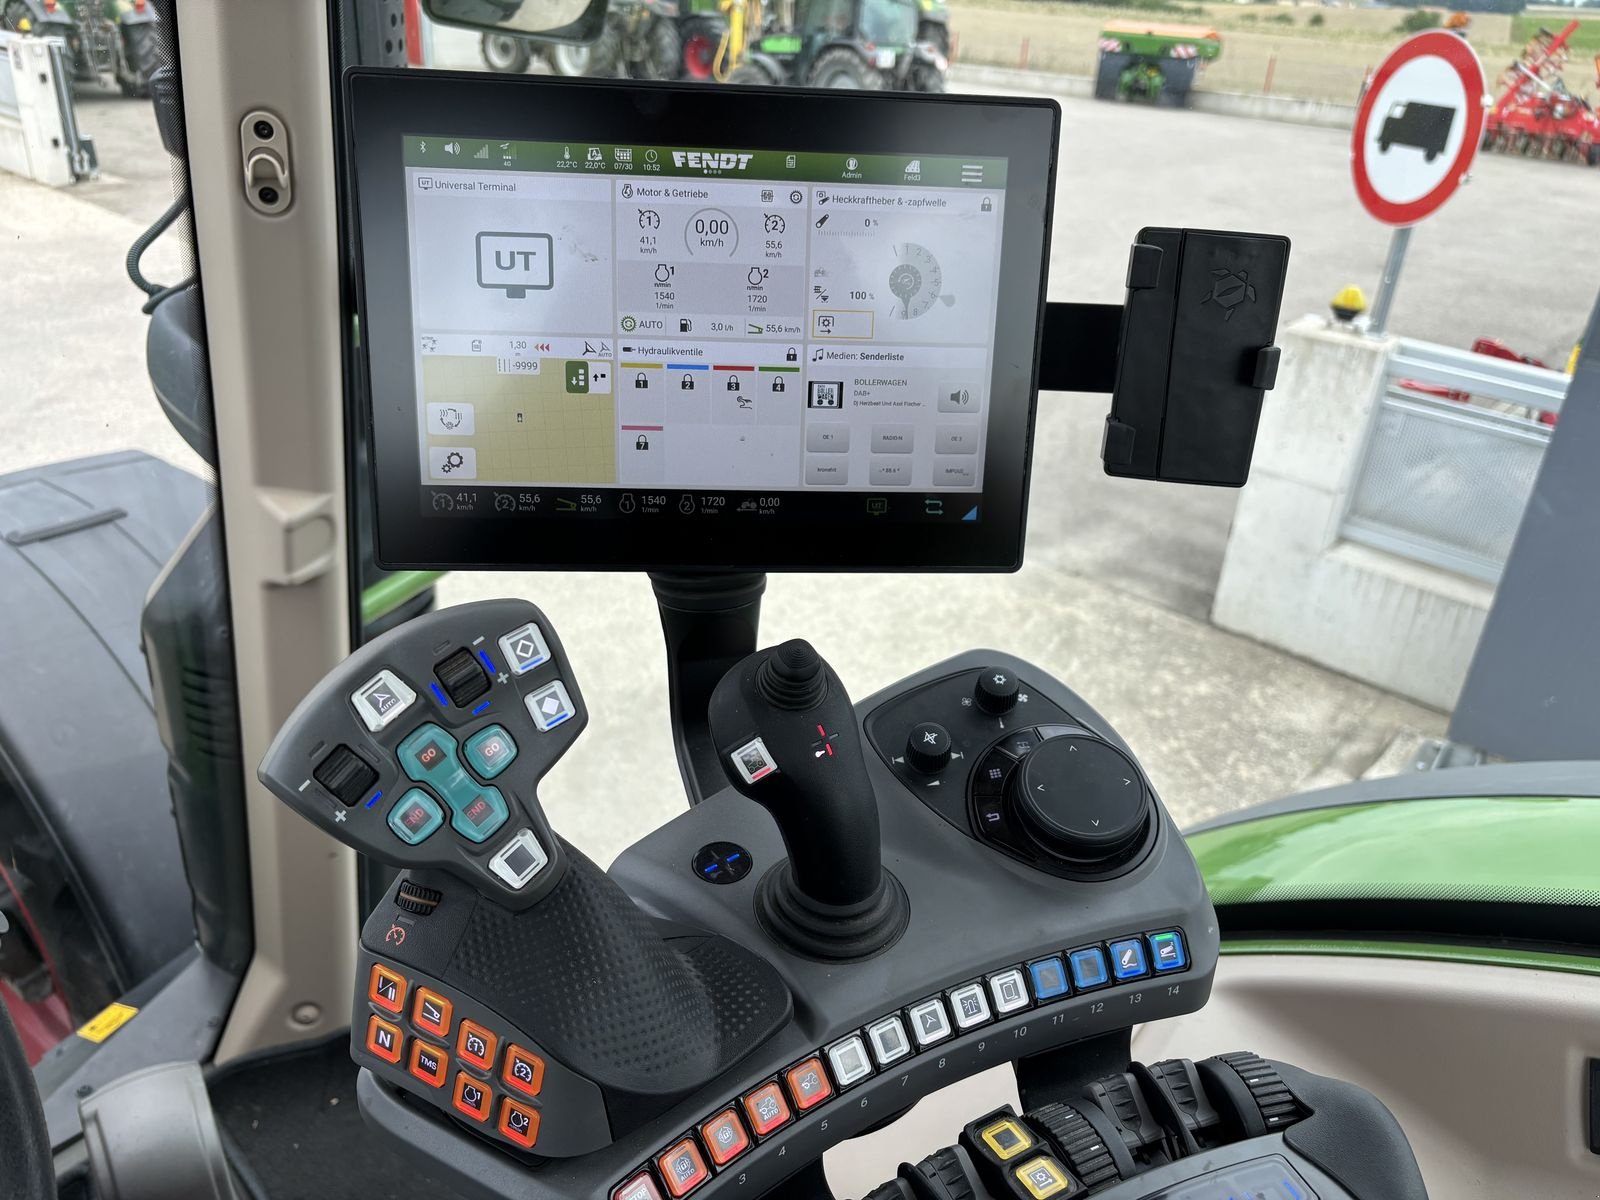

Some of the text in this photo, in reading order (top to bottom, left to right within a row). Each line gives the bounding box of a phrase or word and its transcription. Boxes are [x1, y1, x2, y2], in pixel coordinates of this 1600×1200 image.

[556, 160, 578, 168] 22,2°C
[672, 151, 754, 170] FENDT
[585, 162, 606, 170] 22,0°C
[614, 162, 633, 170] 07/30
[842, 171, 862, 180] Admin
[435, 181, 516, 192] Universal Terminal
[637, 188, 708, 198] Motor & Getriebe
[832, 194, 896, 206] Heckkraftheber
[904, 198, 946, 208] -zapfwelle
[695, 218, 729, 236] 0,00
[864, 218, 870, 228] 0
[640, 236, 657, 246] 41,1
[700, 238, 724, 248] km/h
[765, 240, 783, 250] 55,6
[765, 250, 782, 258] km/h
[495, 250, 536, 272] UT
[654, 292, 675, 300] 1540
[747, 294, 768, 304] 1720
[850, 291, 867, 300] 100
[655, 302, 674, 310] 1/min
[639, 320, 663, 329] AUTO
[711, 322, 724, 332] 3,0
[766, 324, 800, 334] 55,6 km/h
[509, 340, 527, 350] 1,30
[638, 346, 704, 357] Hydraulikventile
[826, 352, 904, 361] Medien: Senderliste
[512, 361, 538, 371] -9999
[854, 378, 908, 386] BOLLERWAGEN
[456, 493, 477, 504] 41,1
[519, 494, 540, 504] 55,6
[580, 494, 602, 505] 55,6
[642, 496, 666, 505] 1540
[701, 496, 726, 506] 1720
[759, 498, 780, 508] 0,00
[484, 742, 500, 757] GO
[422, 748, 436, 762] GO
[467, 800, 486, 820] END
[405, 808, 424, 826] END
[1168, 985, 1180, 996] 14
[1130, 993, 1142, 1004] 13
[1090, 1002, 1104, 1014] 12
[1052, 1014, 1064, 1025] 11
[1013, 1026, 1028, 1039] 10
[378, 1030, 390, 1048] N
[978, 1042, 985, 1052] 9
[420, 1054, 437, 1070] TMS
[938, 1058, 946, 1069] 8
[902, 1076, 909, 1086] 7
[860, 1097, 868, 1108] 6
[764, 1108, 779, 1121] AUTO
[821, 1120, 828, 1131] 5
[778, 1146, 786, 1156] 4
[681, 1168, 695, 1182] AUTO
[739, 1173, 746, 1185] 3
